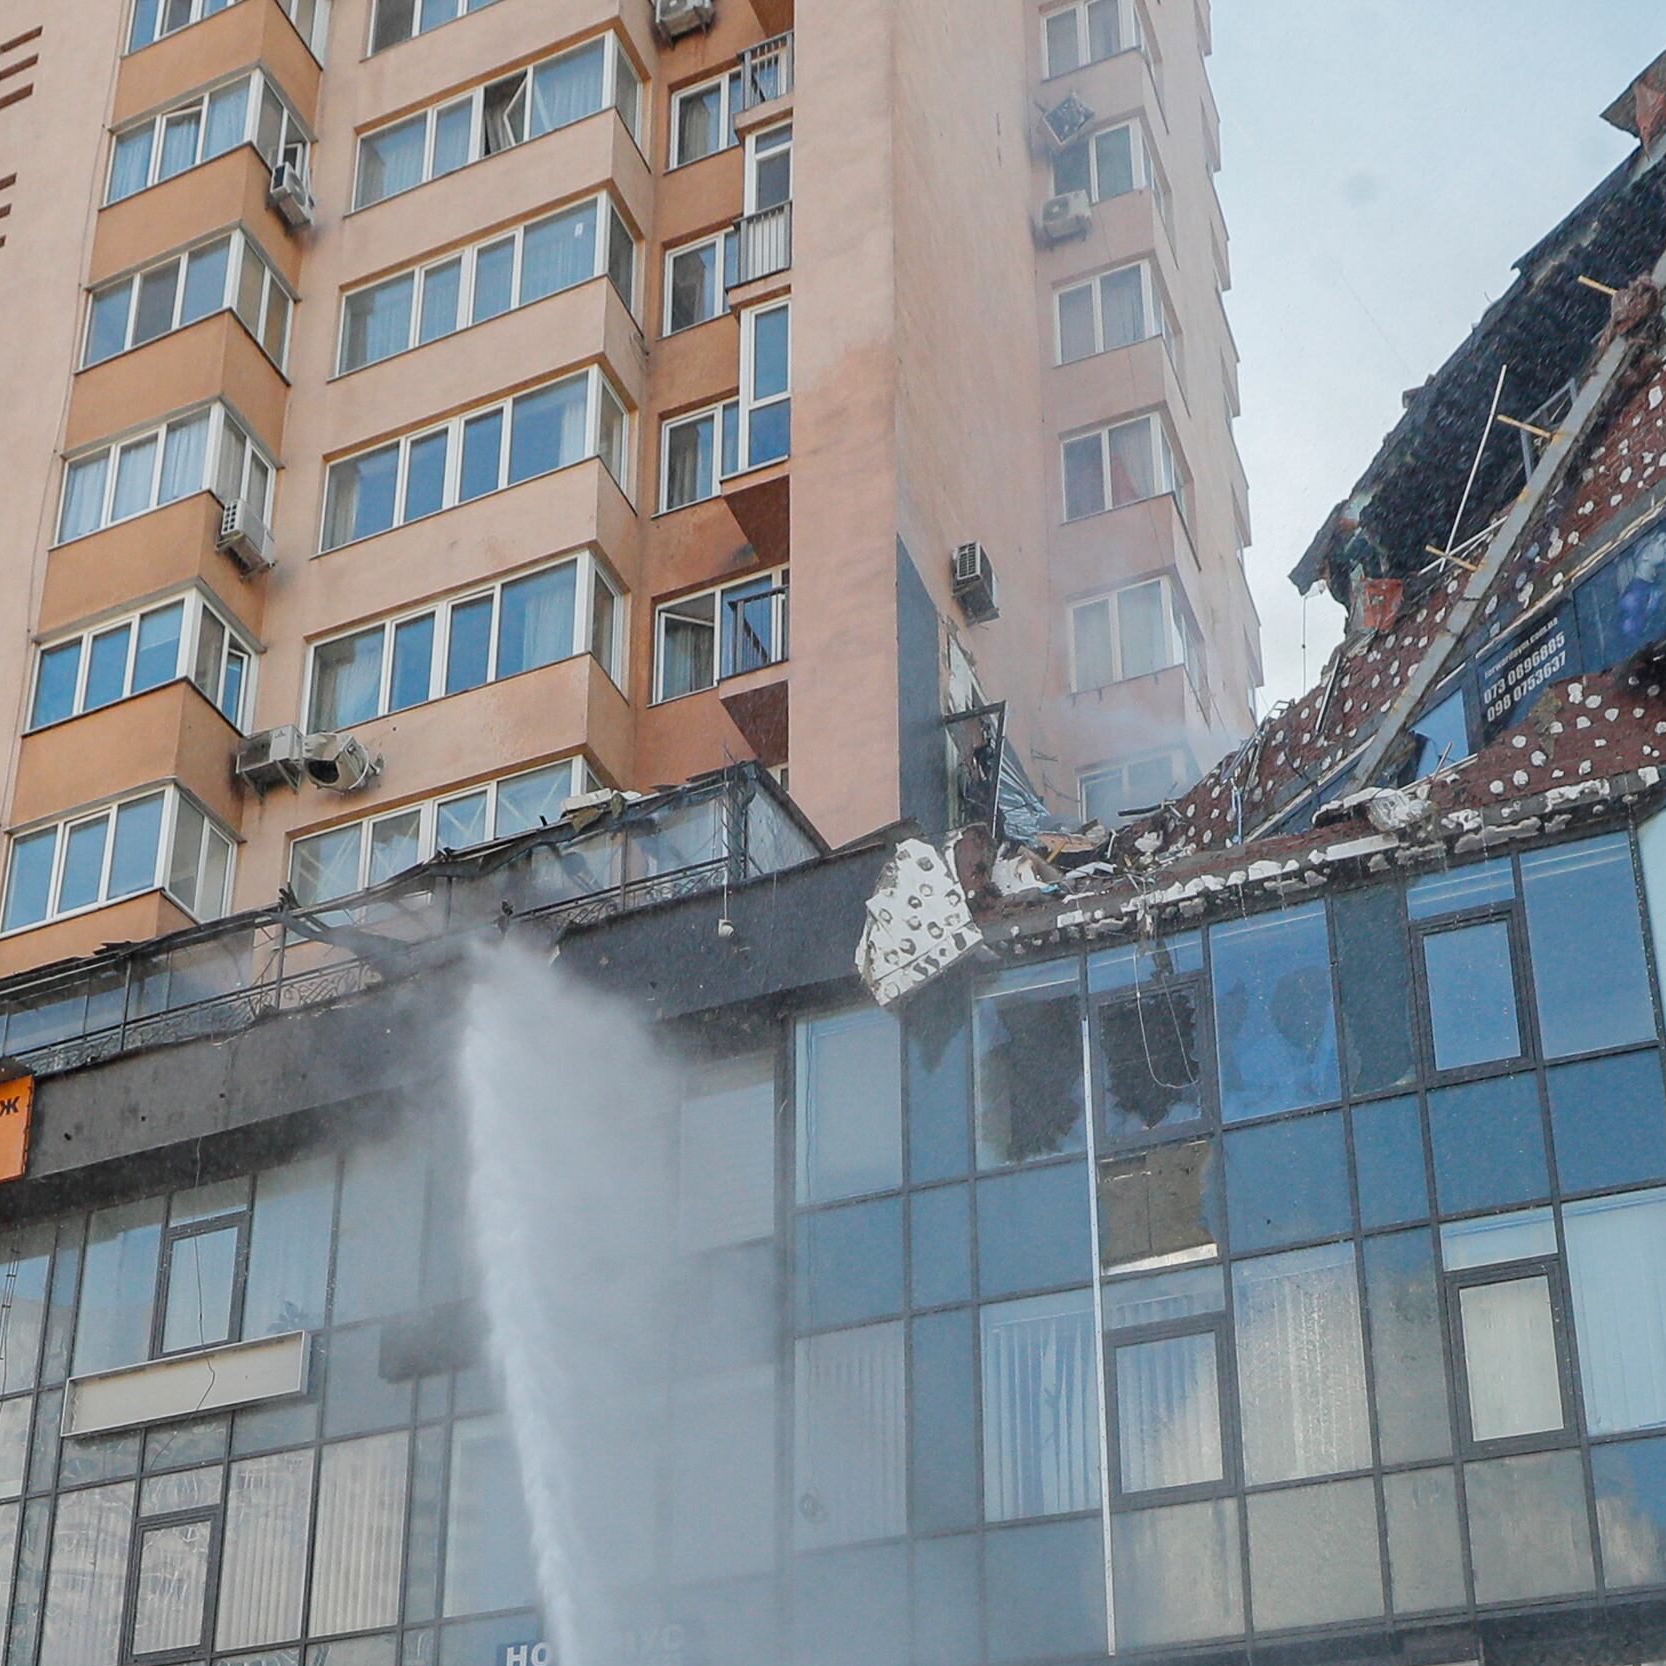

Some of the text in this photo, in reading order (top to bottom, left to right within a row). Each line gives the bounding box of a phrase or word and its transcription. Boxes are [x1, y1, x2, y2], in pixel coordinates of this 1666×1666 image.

[1483, 630, 1566, 704] 073 0896885
[1486, 651, 1568, 723] 098 0753637
